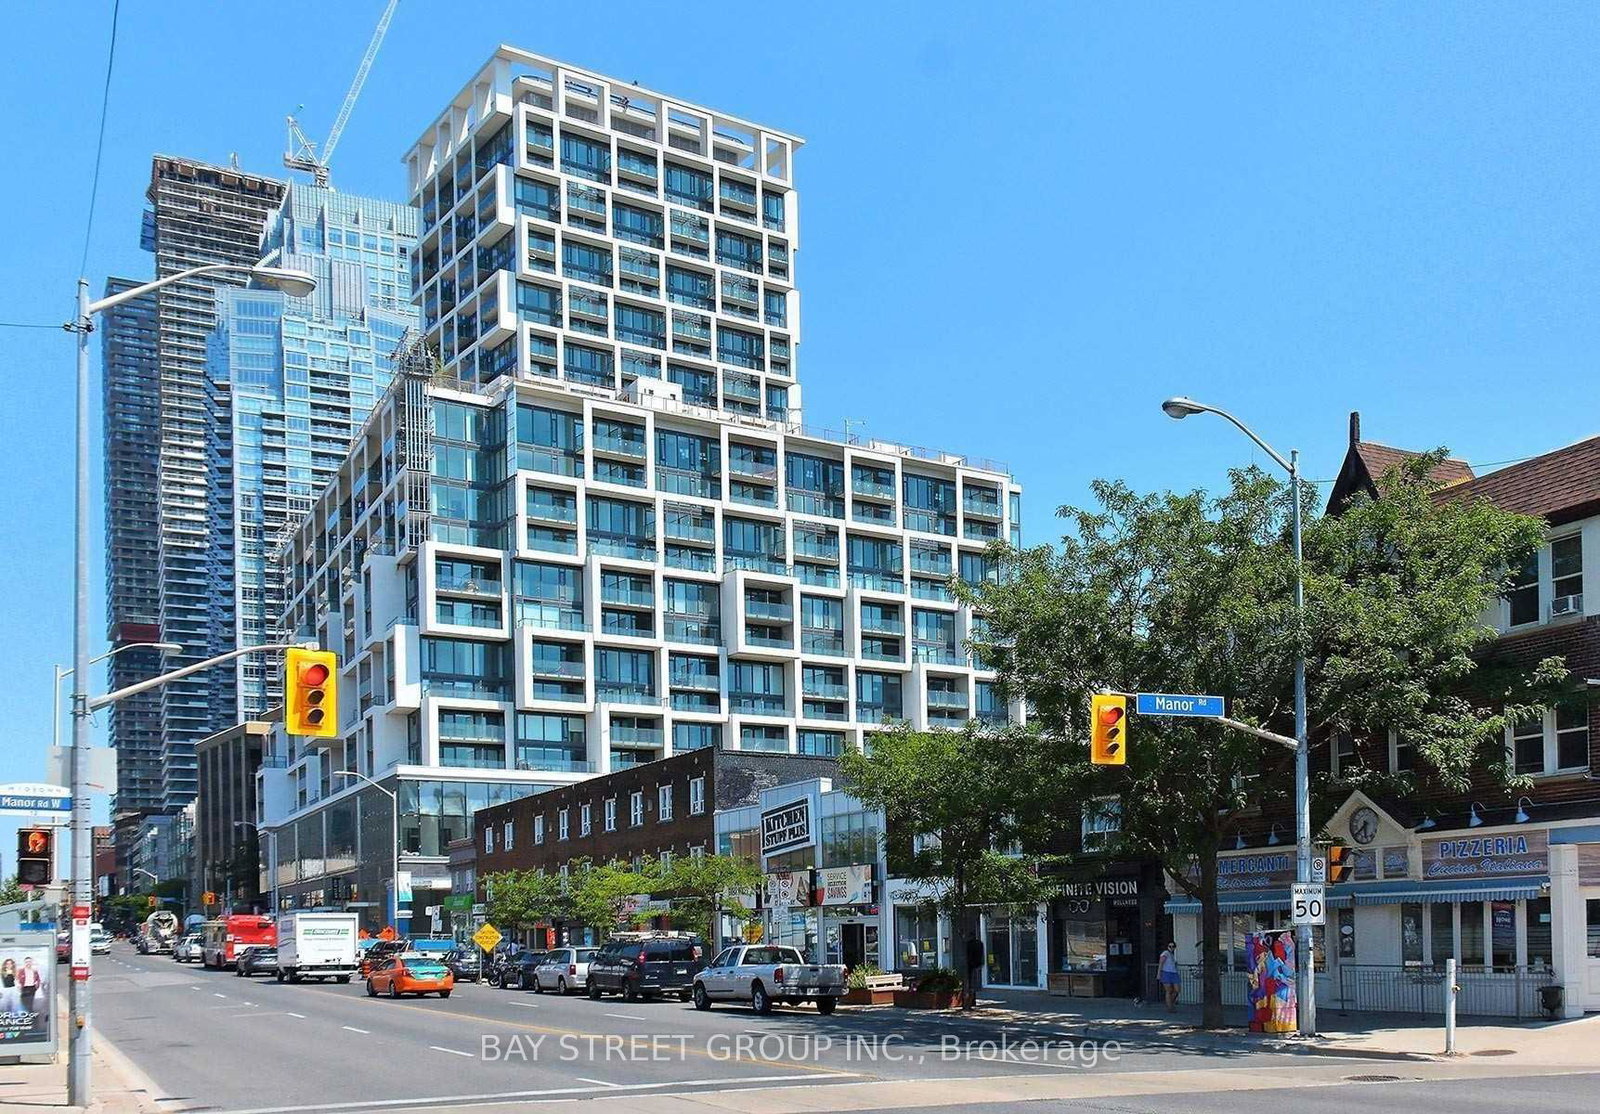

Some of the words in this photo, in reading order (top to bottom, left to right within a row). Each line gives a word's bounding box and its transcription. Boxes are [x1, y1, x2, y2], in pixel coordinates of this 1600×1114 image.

[1155, 696, 1194, 711] Manor
[1198, 698, 1207, 706] Rd
[2, 796, 37, 807] Manor
[51, 799, 60, 808] W
[765, 805, 805, 832] KITCHEN
[765, 829, 788, 846] STUFF
[788, 824, 806, 841] PLUS
[1440, 835, 1529, 859] PIZZERIA
[1217, 855, 1289, 875] MERCANTI
[826, 872, 847, 882] SERVICE
[1095, 881, 1138, 895] VISION
[1296, 900, 1321, 917] 50
